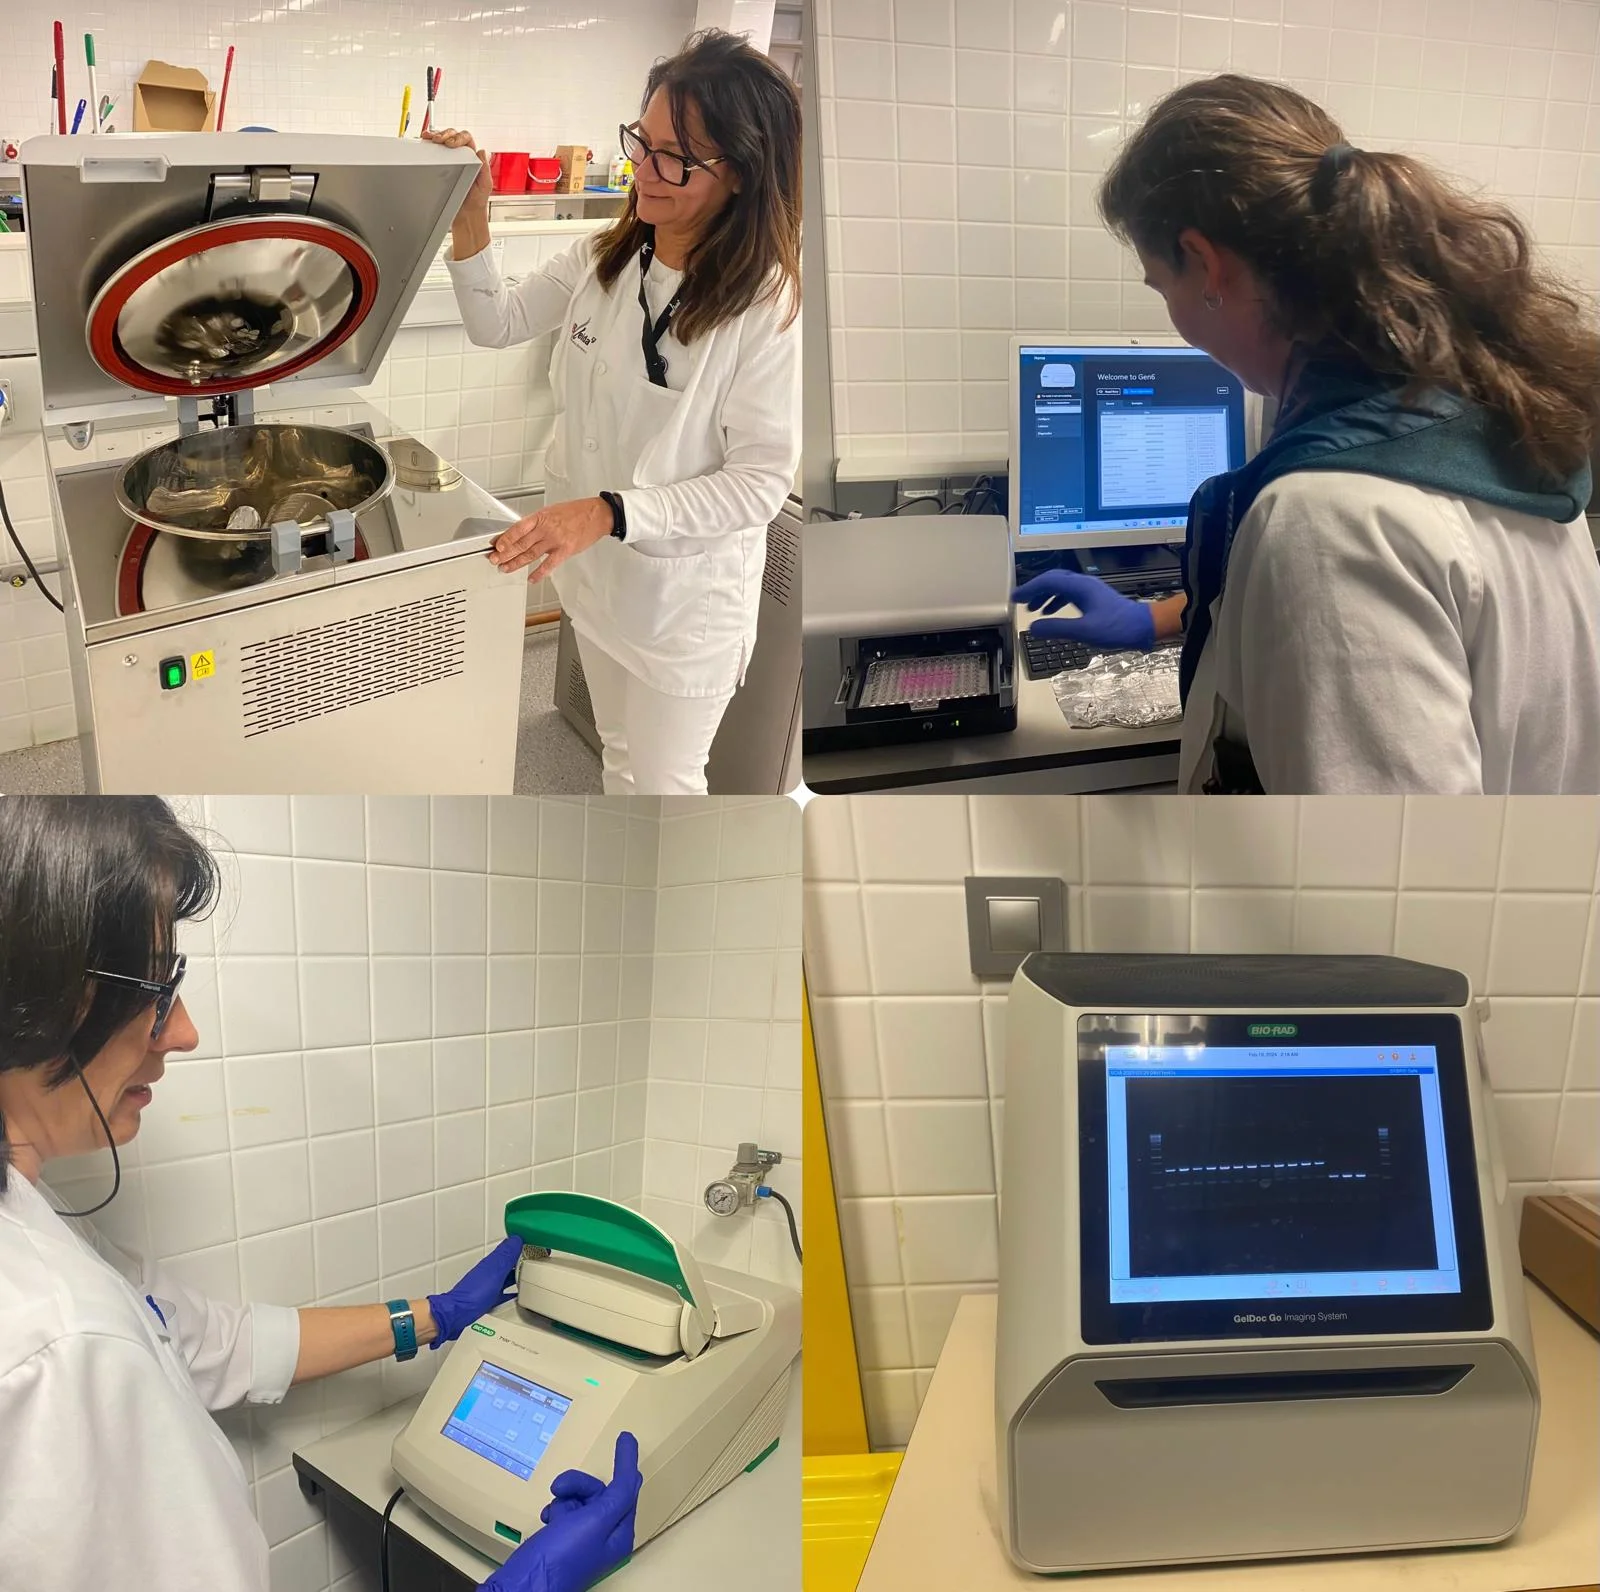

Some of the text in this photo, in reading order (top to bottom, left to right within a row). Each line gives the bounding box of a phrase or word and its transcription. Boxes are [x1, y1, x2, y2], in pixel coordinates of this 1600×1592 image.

[1097, 372, 1156, 381] Welcome to Gen6
[1251, 1026, 1296, 1036] BIO-RAD
[1233, 1311, 1348, 1323] GelDoc Go Imaging System
